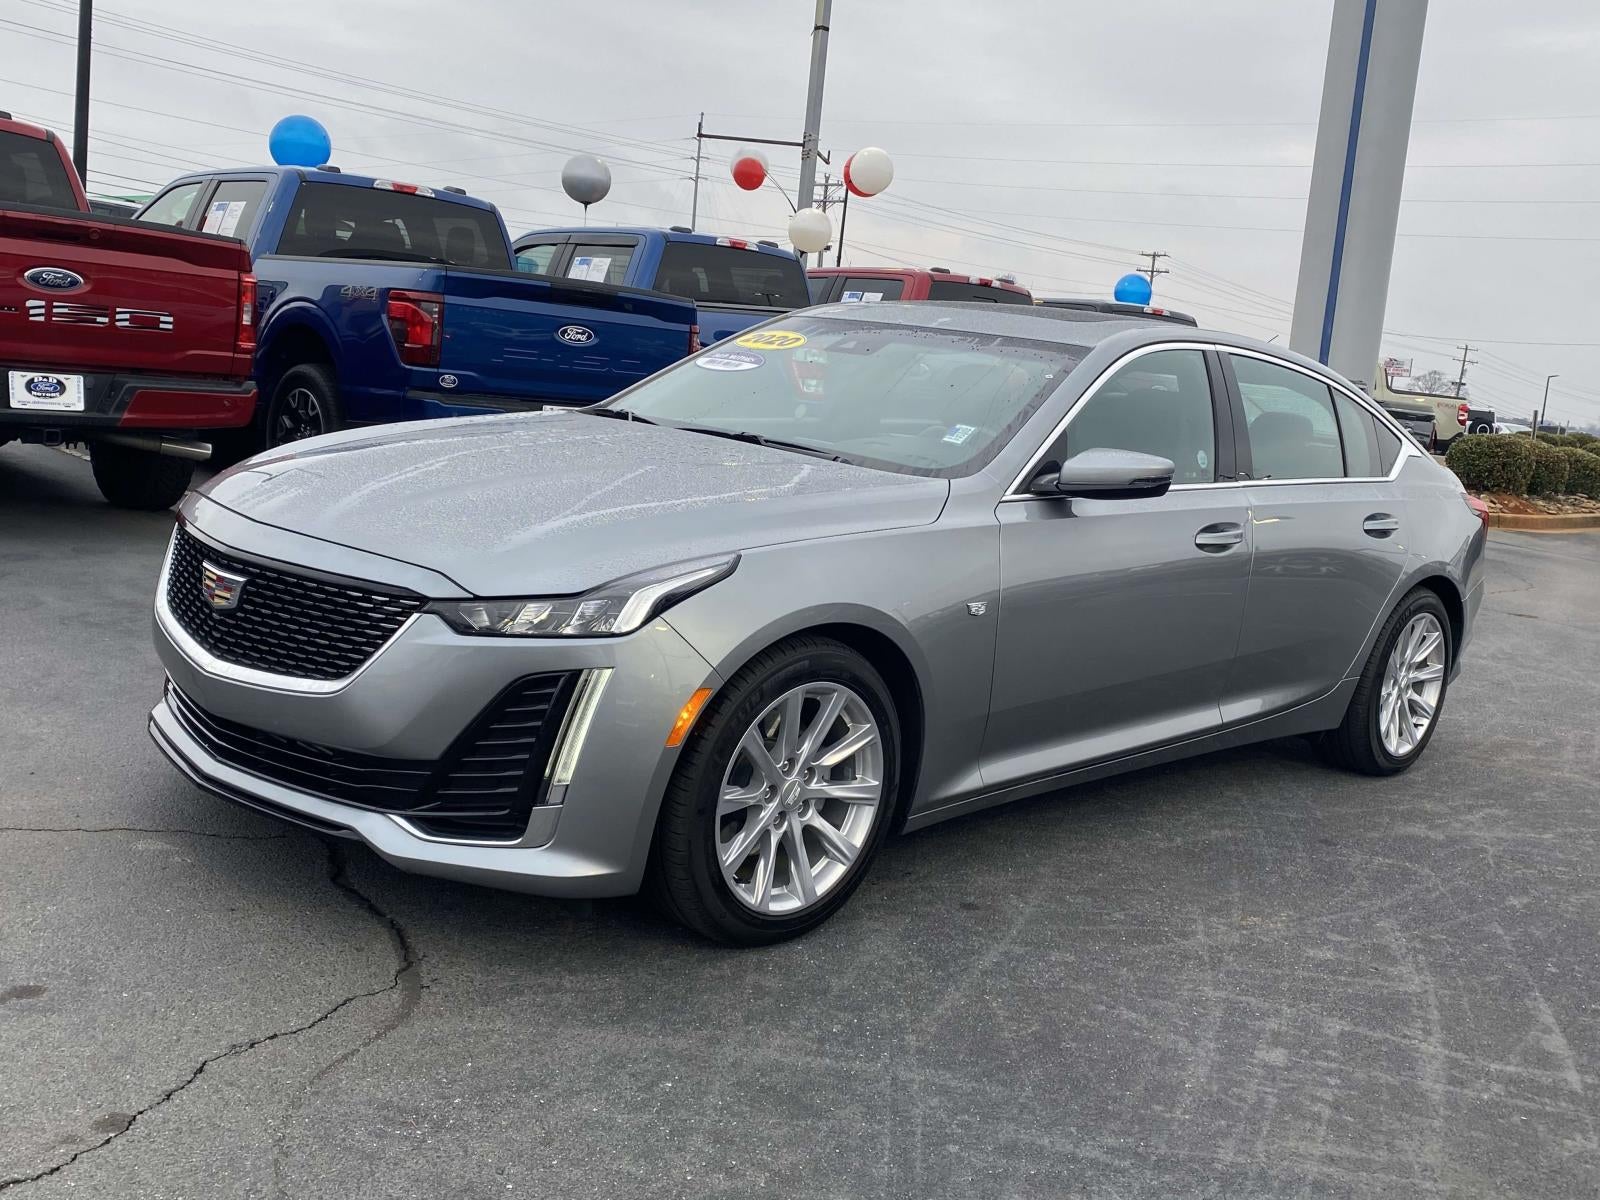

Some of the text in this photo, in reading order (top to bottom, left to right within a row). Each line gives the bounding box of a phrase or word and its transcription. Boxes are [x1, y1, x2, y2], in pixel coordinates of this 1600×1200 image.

[39, 271, 71, 287] Ford
[564, 327, 589, 341] Ford
[739, 333, 802, 347] 2020
[33, 376, 58, 384] D&D
[36, 382, 55, 391] Ford
